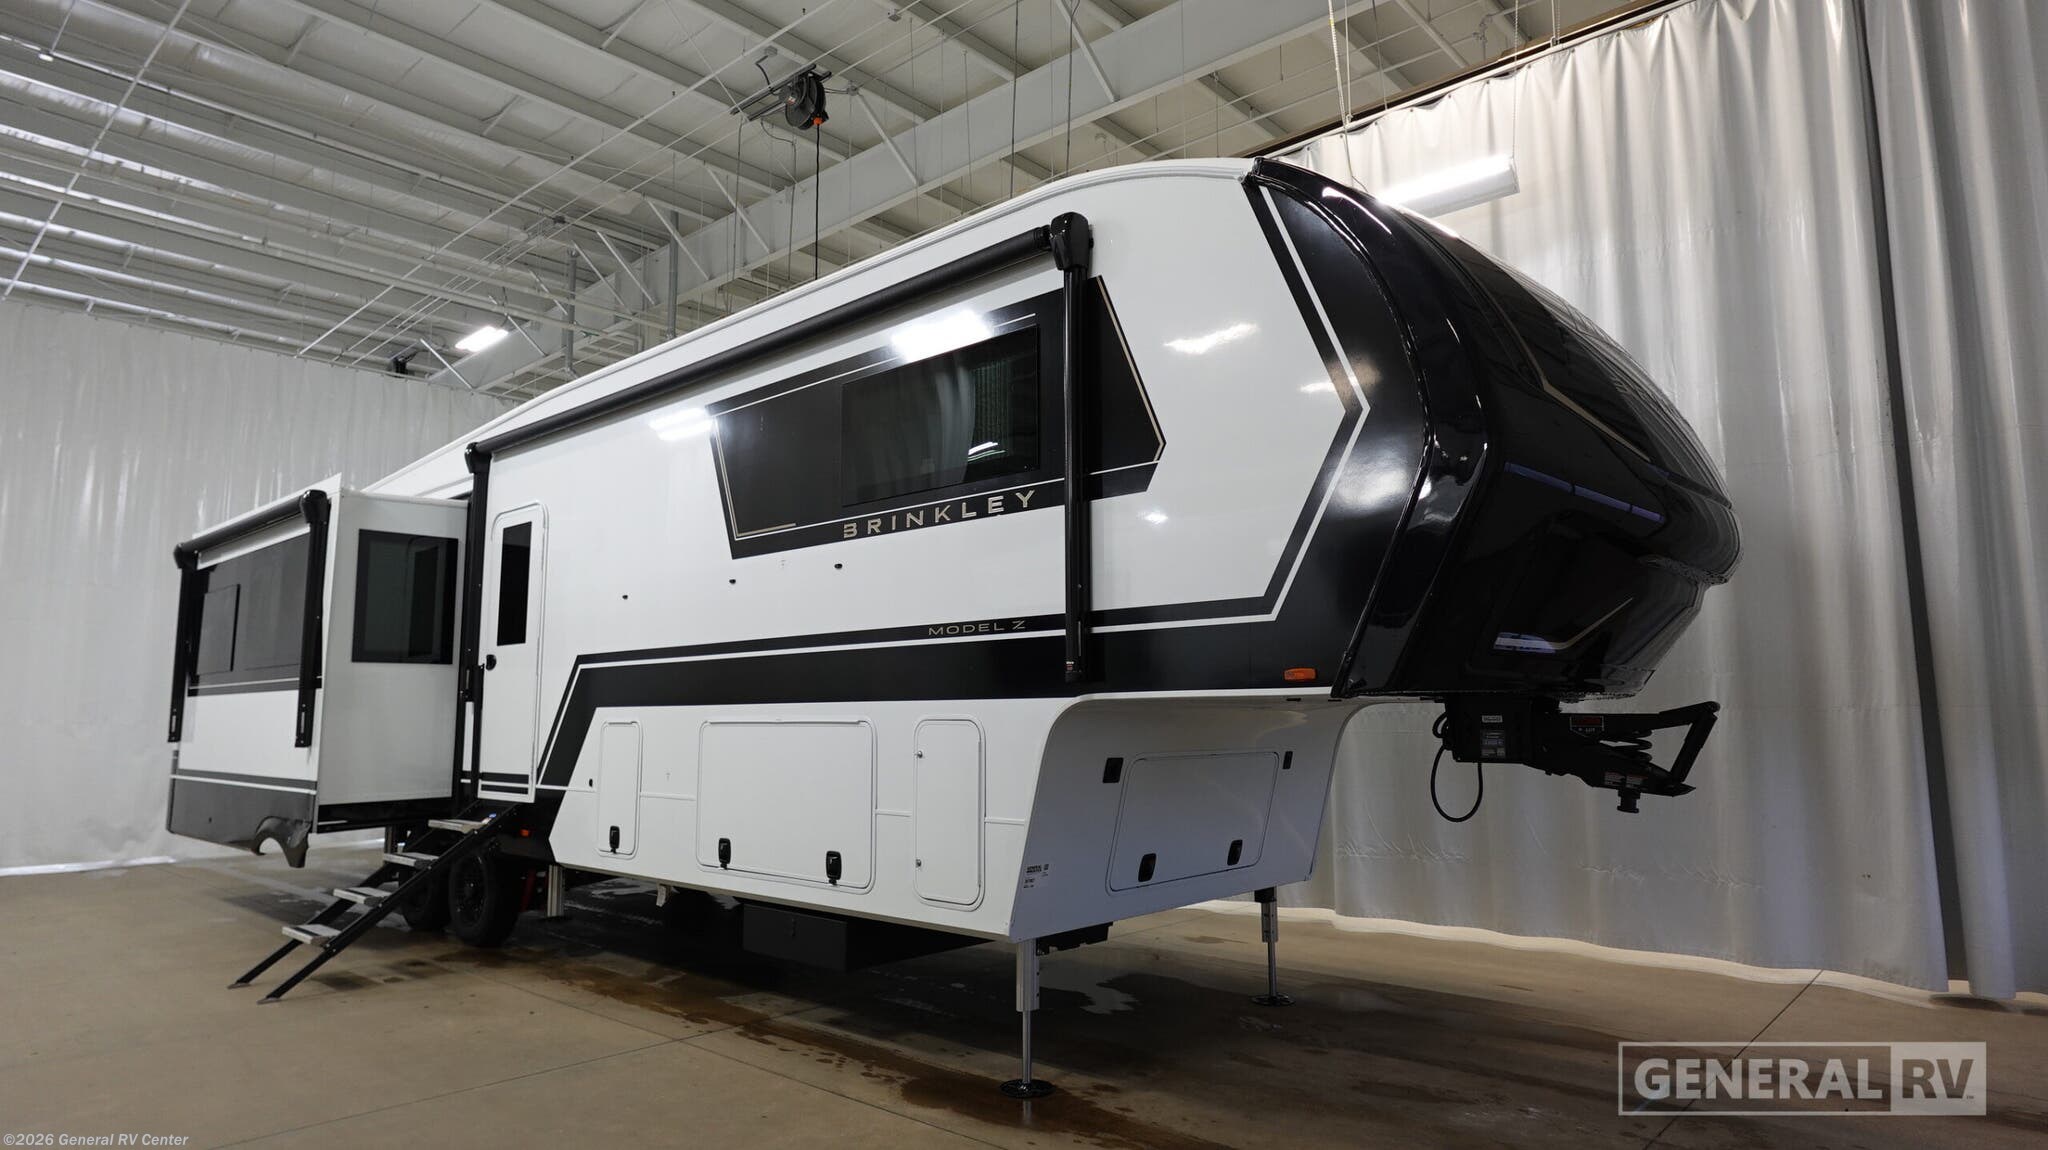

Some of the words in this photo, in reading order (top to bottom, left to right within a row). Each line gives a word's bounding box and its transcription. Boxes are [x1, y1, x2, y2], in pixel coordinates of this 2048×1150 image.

[843, 489, 1036, 539] BRINKLEY
[928, 622, 1005, 636] MODEL
[1012, 619, 1027, 631] Z
